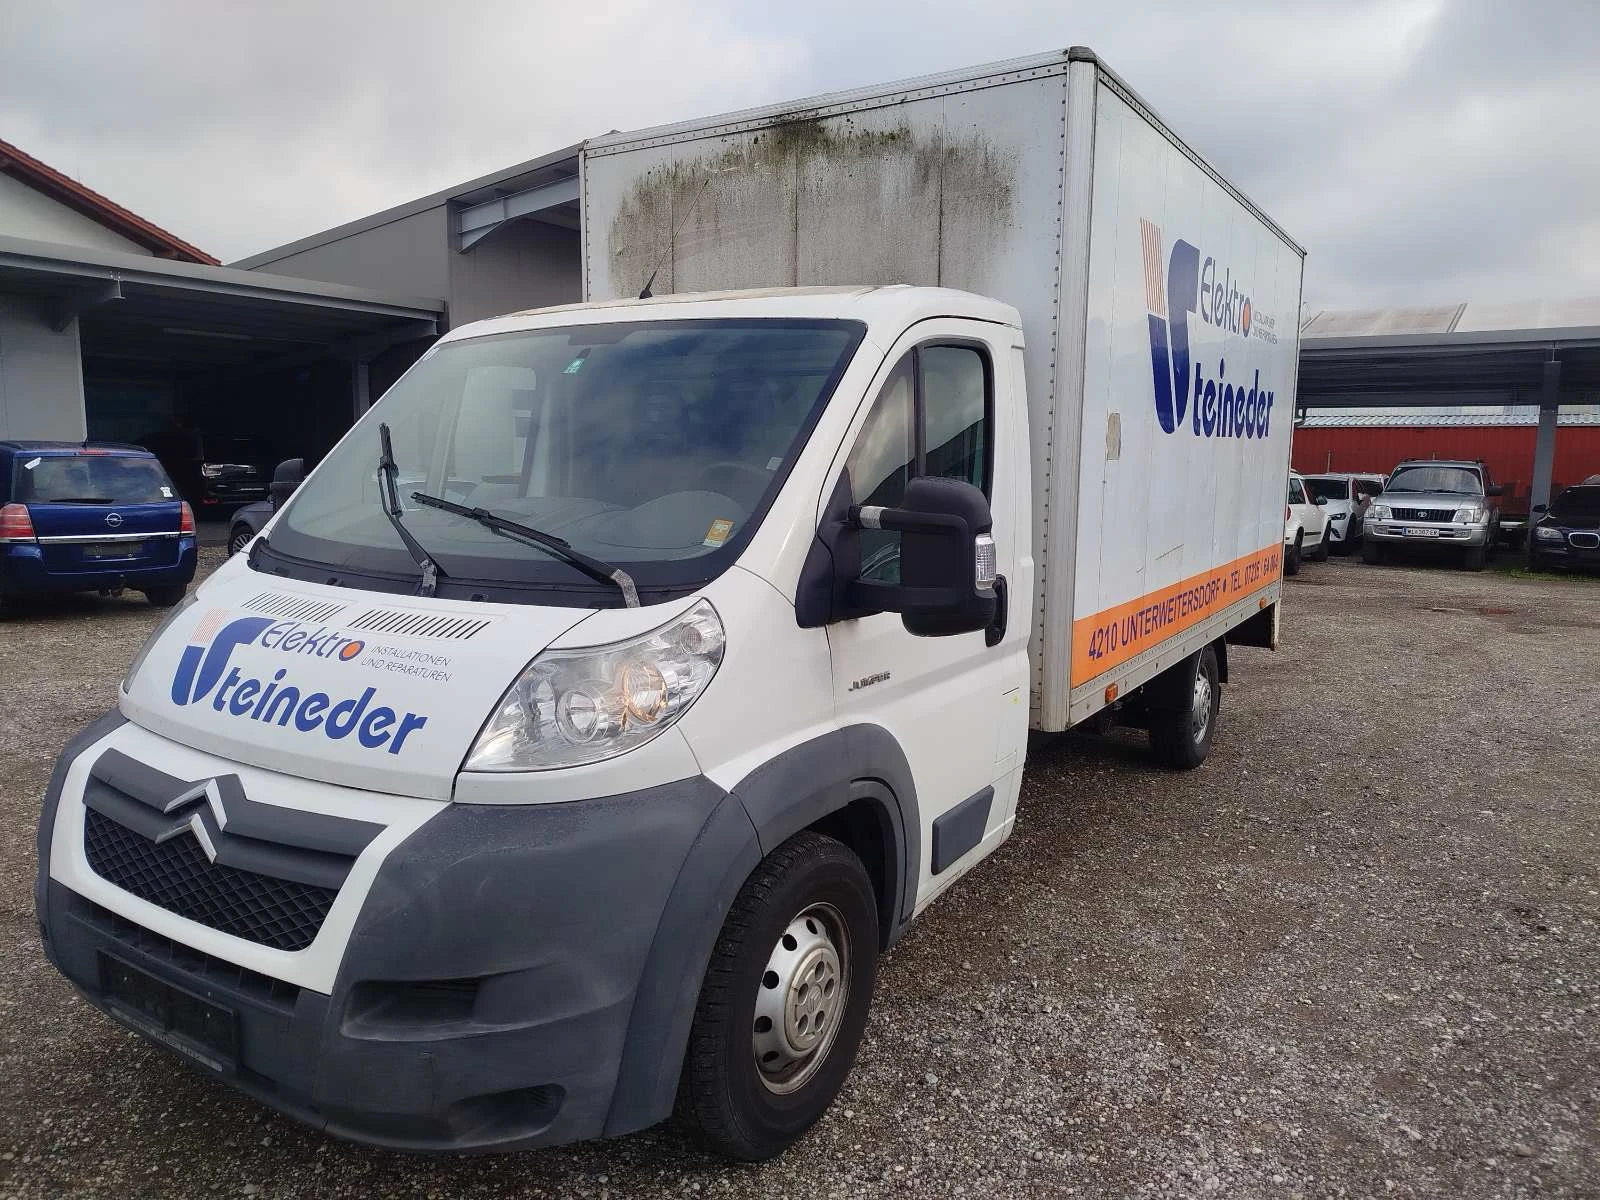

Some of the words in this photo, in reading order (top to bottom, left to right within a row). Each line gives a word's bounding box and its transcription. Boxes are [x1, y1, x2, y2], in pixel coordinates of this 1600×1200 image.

[1200, 256, 1252, 338] Elektro
[1088, 621, 1118, 662] 4210
[1121, 577, 1221, 647] UNTERWEITERSDORF
[261, 621, 366, 662] Elektro
[370, 646, 453, 668] INSTALLATIONEN
[361, 656, 385, 670] UND
[384, 661, 454, 682] REPARATUREN
[847, 670, 891, 692] JUMPER
